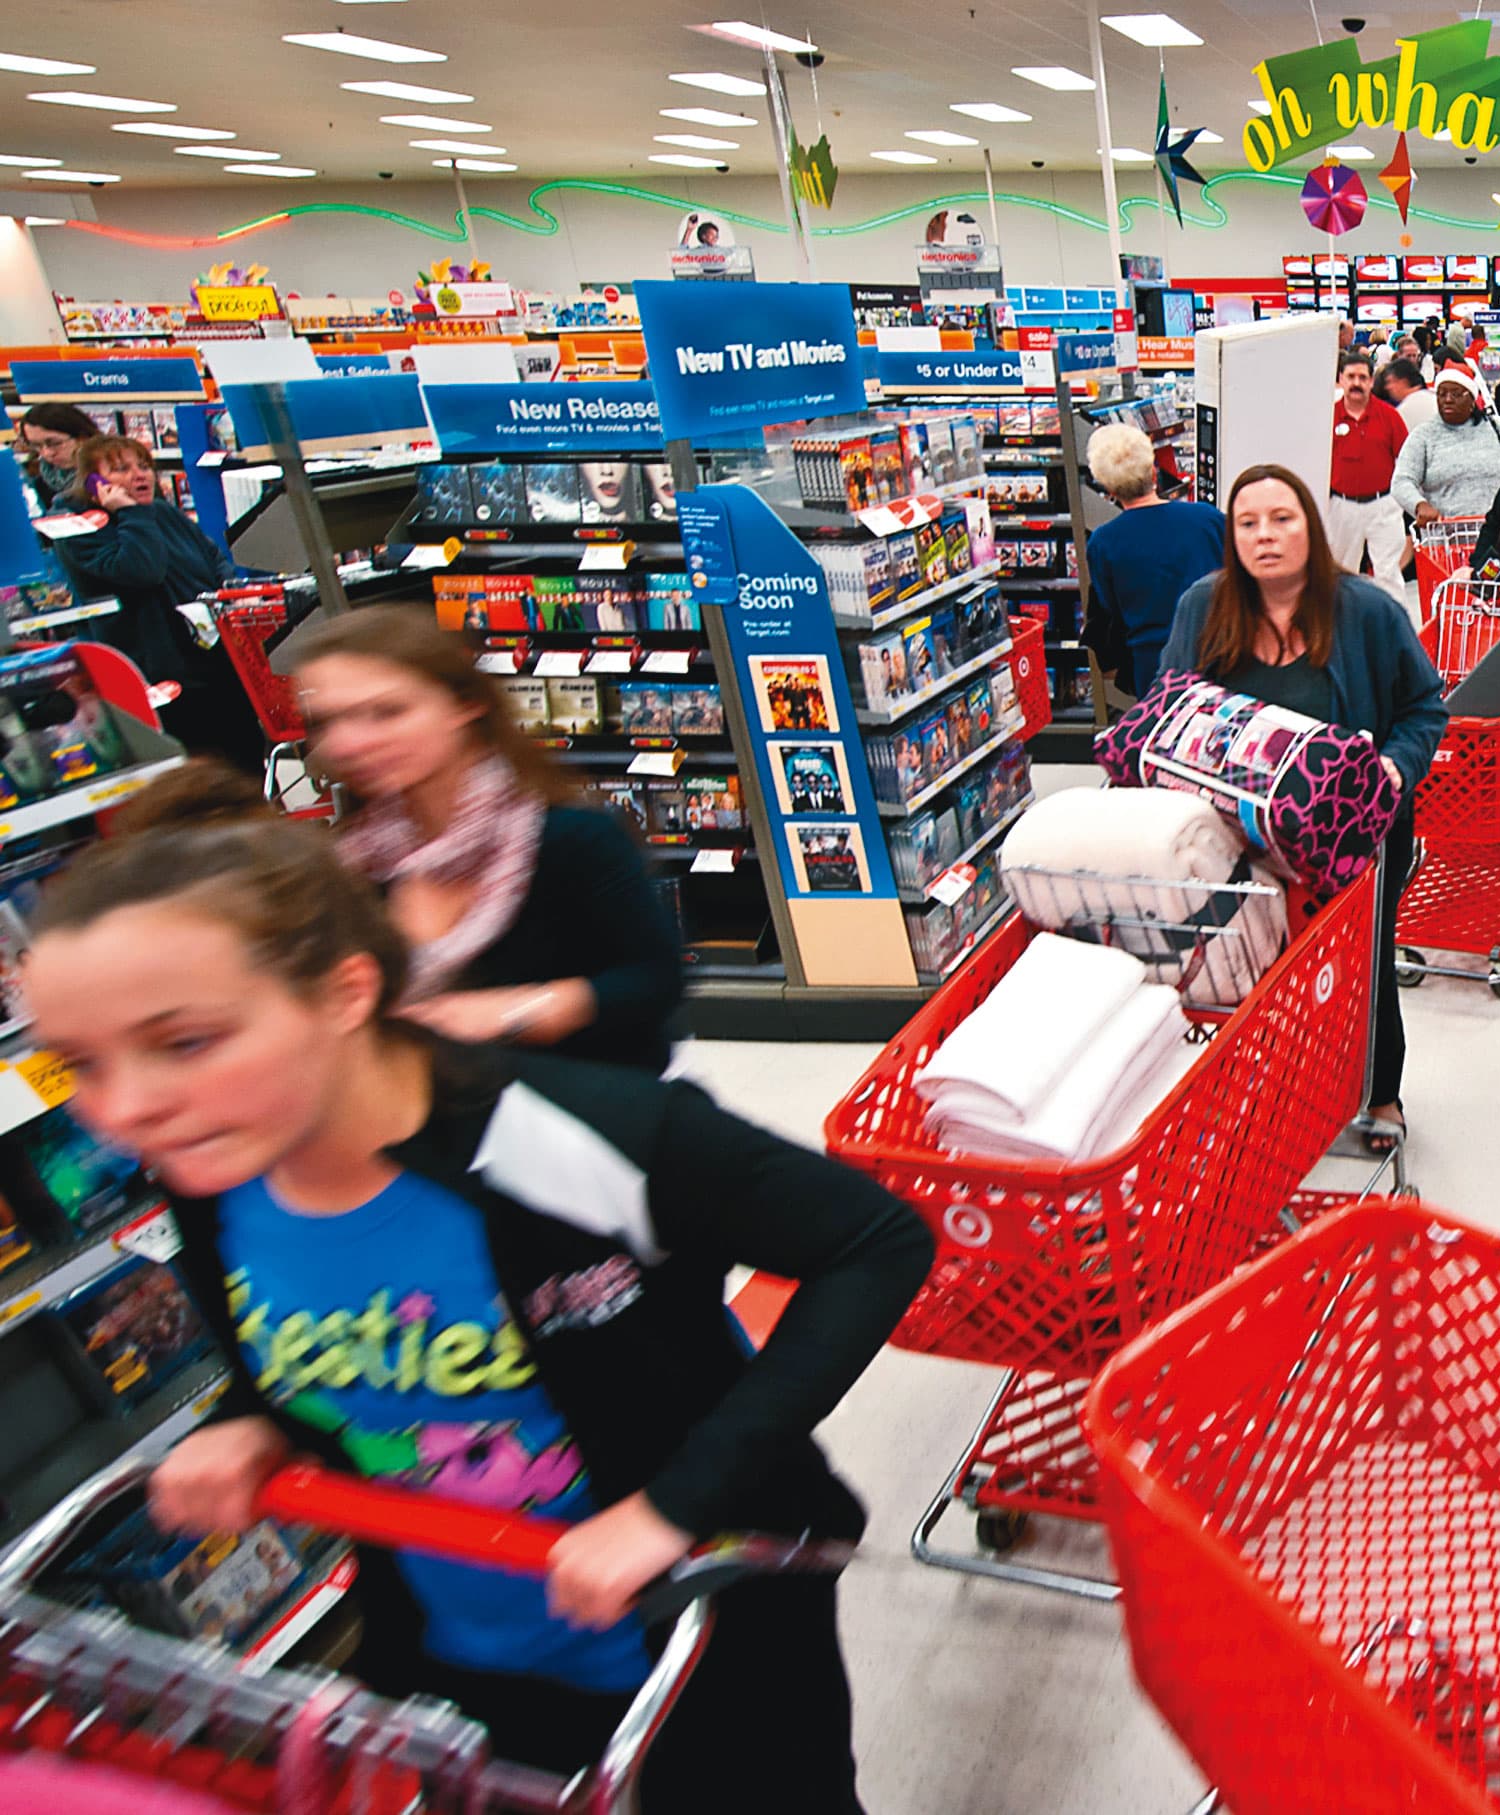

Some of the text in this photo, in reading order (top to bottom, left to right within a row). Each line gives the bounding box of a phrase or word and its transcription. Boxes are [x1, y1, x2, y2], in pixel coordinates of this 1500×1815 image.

[1243, 58, 1312, 172] oh
[1142, 338, 1169, 350] Hear
[676, 339, 846, 375] New TV and Movies
[83, 371, 129, 386] Drama
[917, 363, 931, 378] $5
[935, 366, 950, 378] or
[953, 363, 997, 378] Under
[510, 399, 561, 420] New
[496, 423, 517, 433] Find
[571, 424, 584, 433] TV
[737, 572, 818, 595] Coming
[739, 591, 794, 610] Soon
